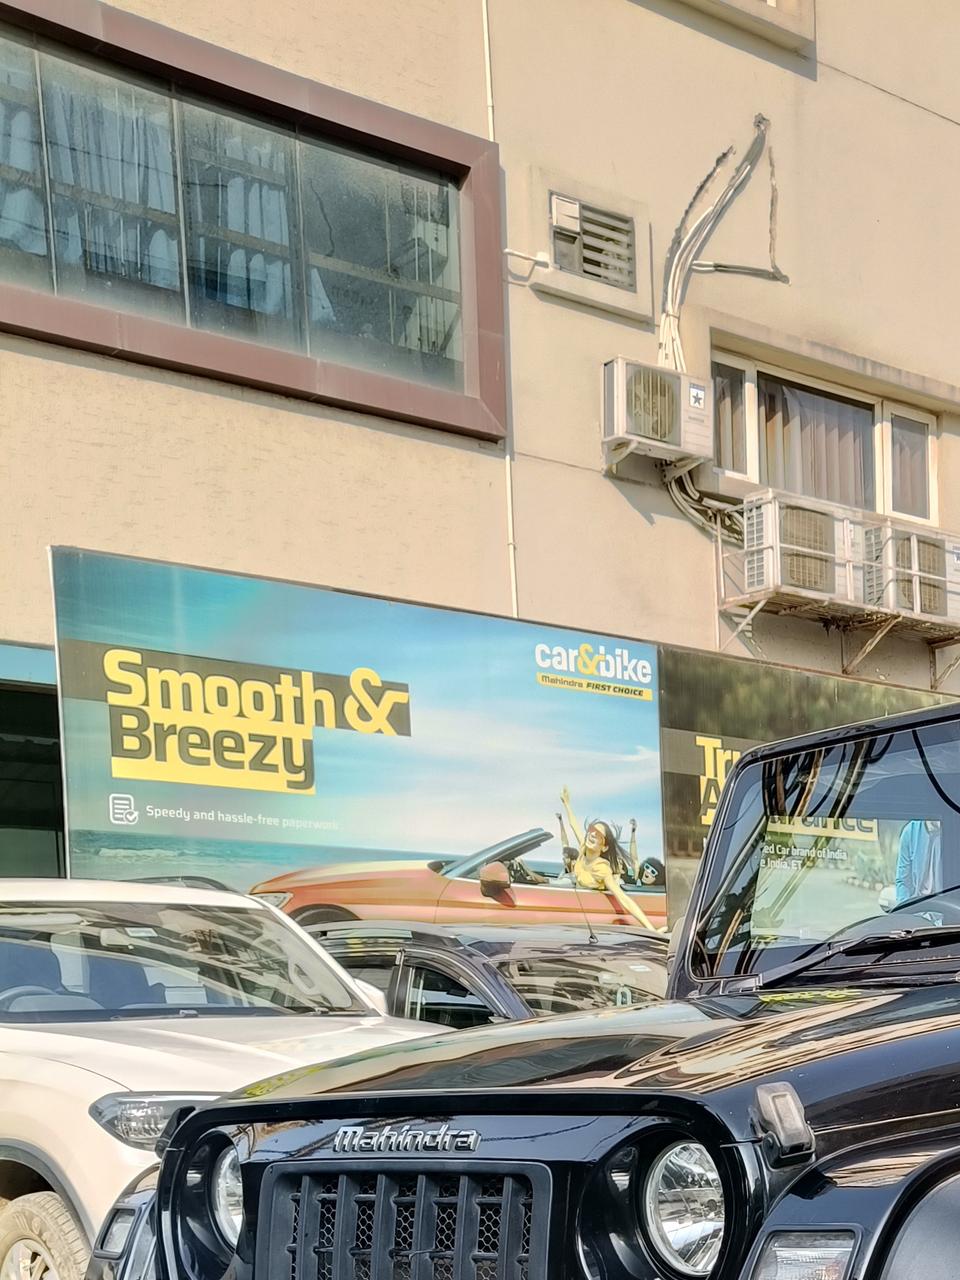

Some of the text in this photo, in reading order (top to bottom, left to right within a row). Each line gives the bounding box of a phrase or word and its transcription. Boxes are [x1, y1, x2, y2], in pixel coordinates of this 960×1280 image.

[535, 643, 652, 683] car&bike
[103, 648, 409, 735] Smooth &
[541, 675, 644, 697] Mahindra FIRST CHOICE
[109, 704, 315, 790] Breezy
[146, 805, 190, 821] Speedy
[193, 810, 215, 821] and
[217, 811, 280, 826] hassle-free
[791, 847, 816, 857] brand
[827, 849, 848, 859] India
[333, 1124, 482, 1153] Mahindra
